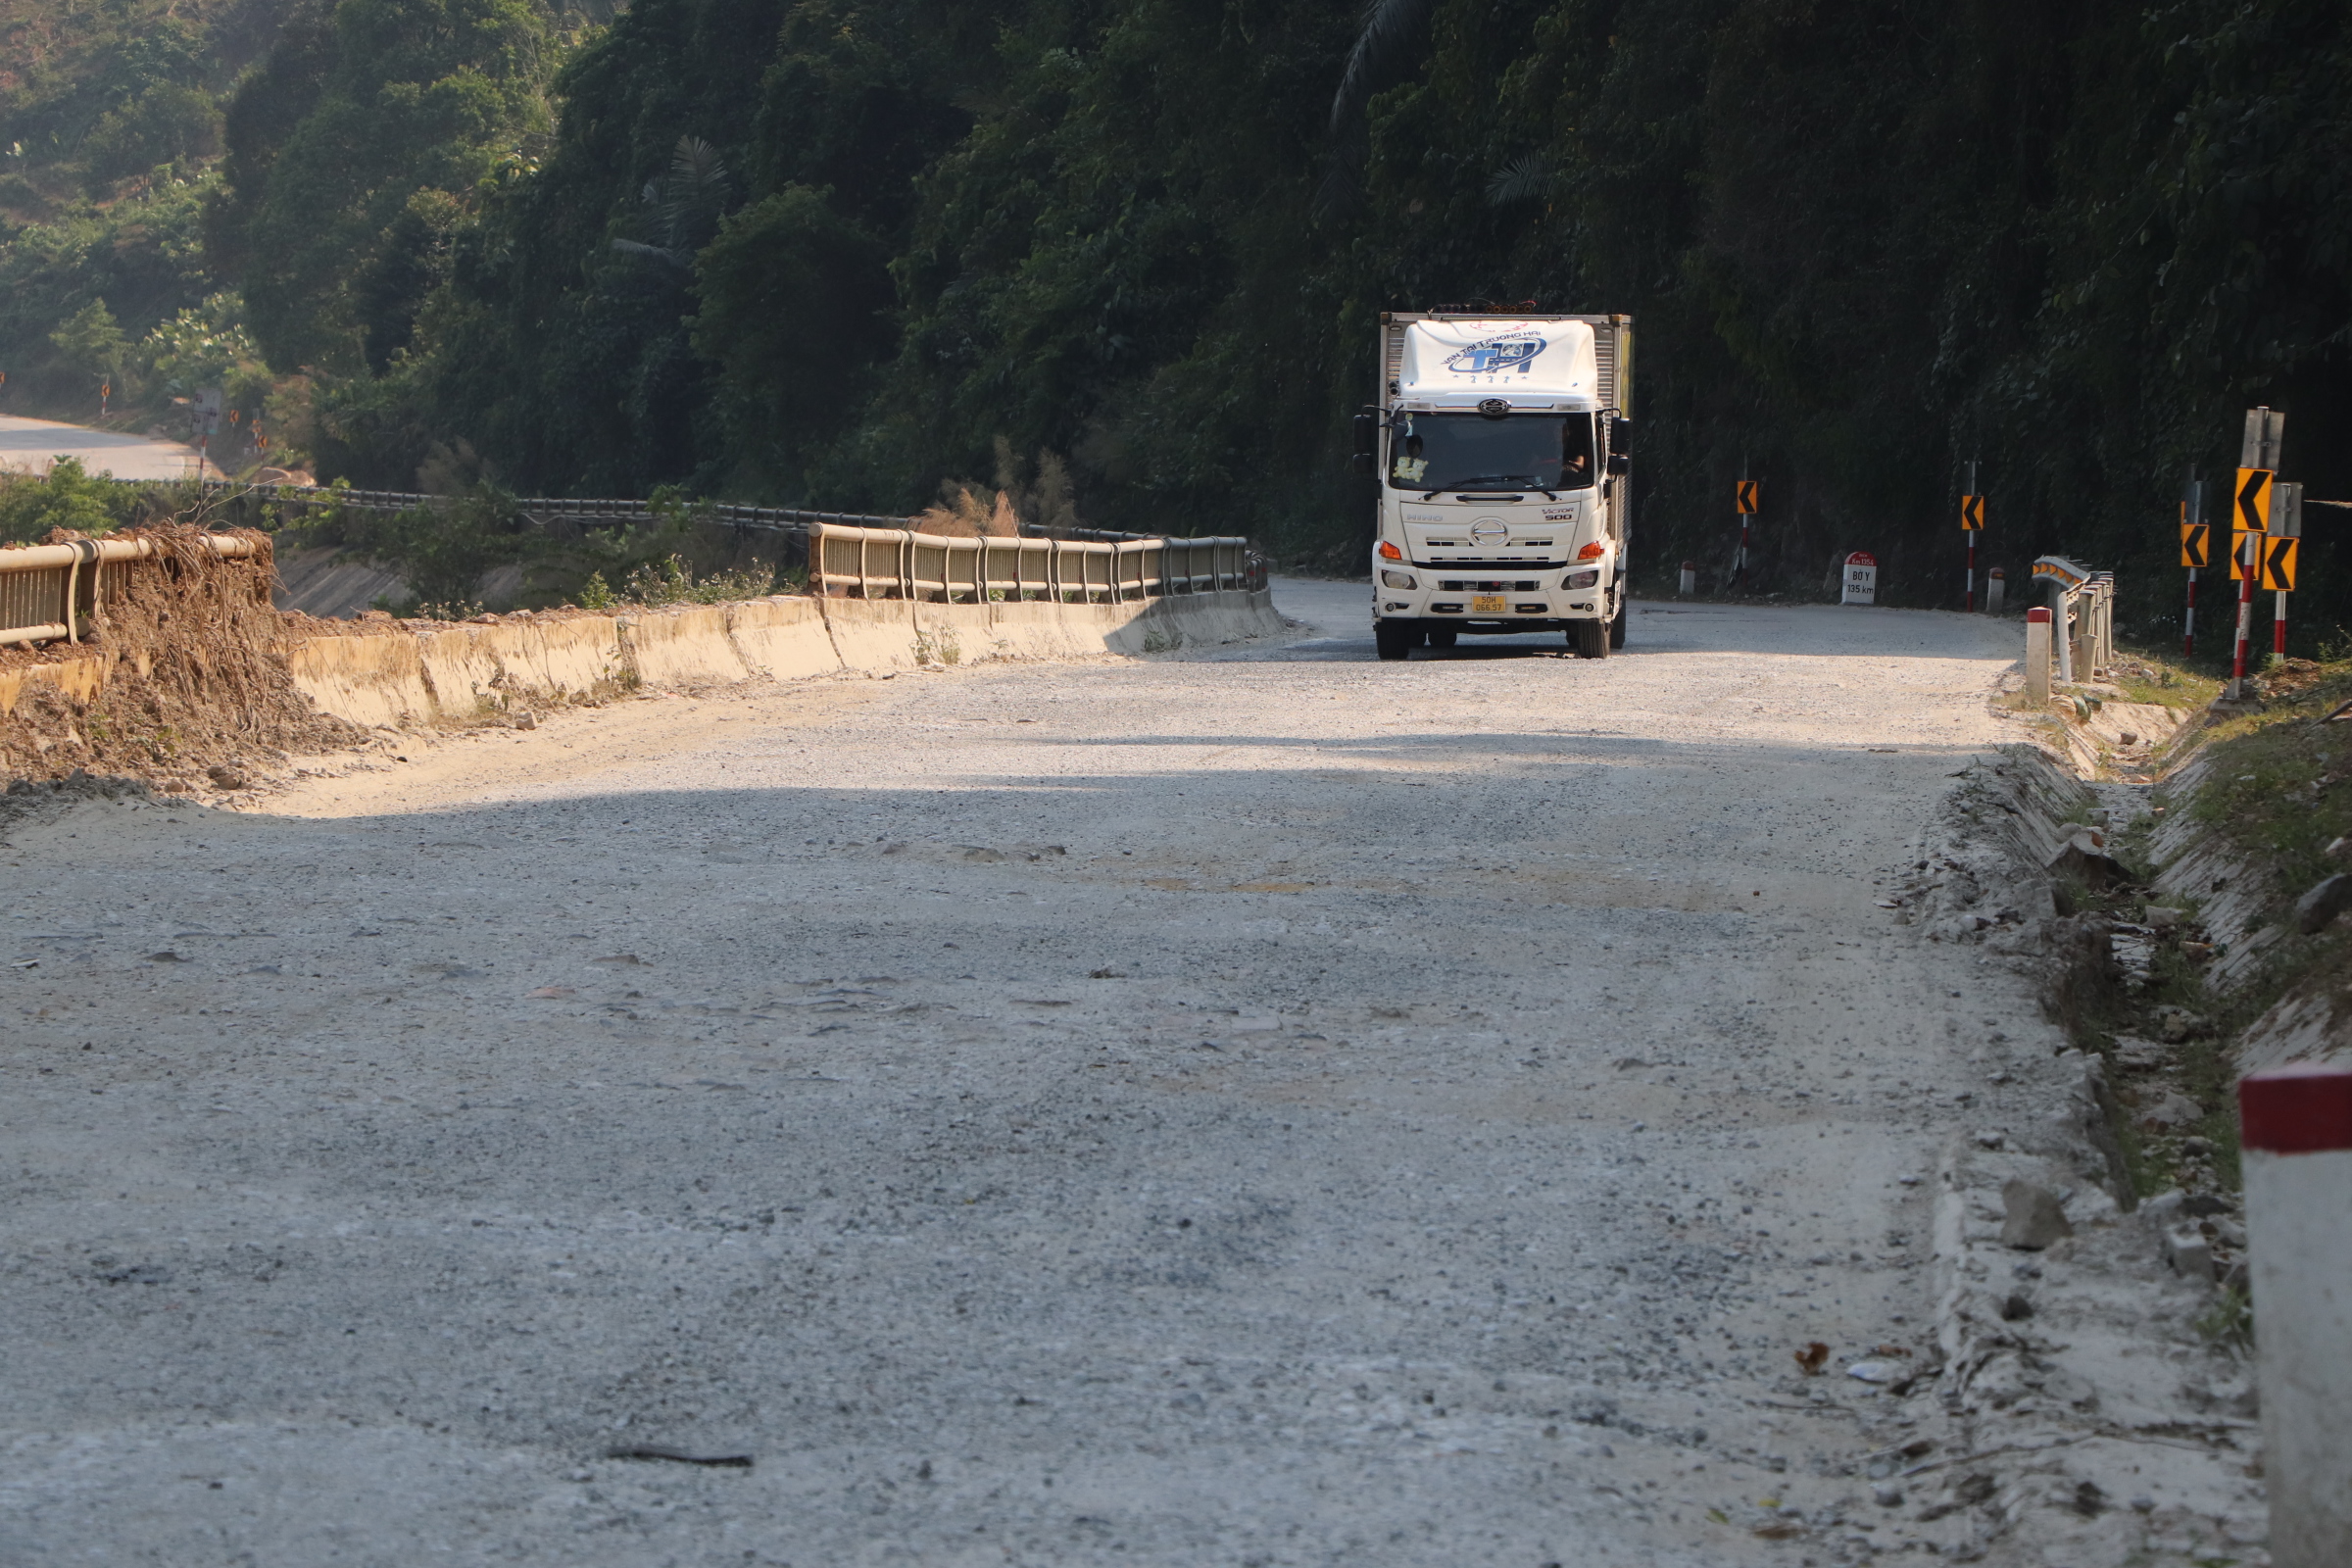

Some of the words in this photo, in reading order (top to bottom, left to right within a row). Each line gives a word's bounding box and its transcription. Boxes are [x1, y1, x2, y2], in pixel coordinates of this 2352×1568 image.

[1406, 514, 1444, 522] HINO
[1865, 571, 1870, 581] Y
[1847, 584, 1860, 593] 135
[1861, 585, 1874, 594] km
